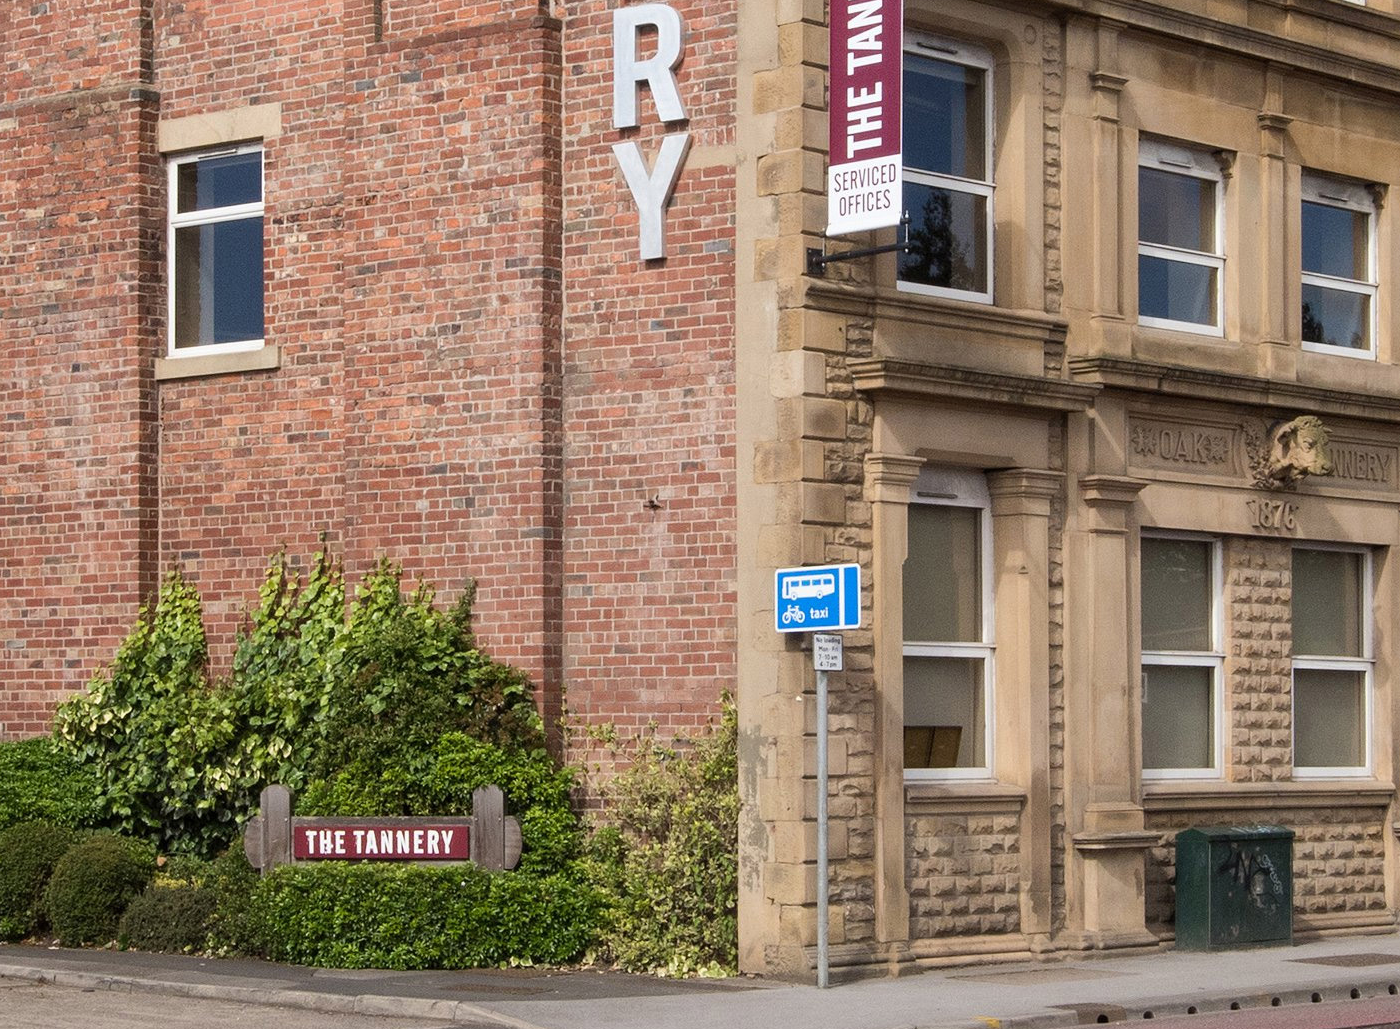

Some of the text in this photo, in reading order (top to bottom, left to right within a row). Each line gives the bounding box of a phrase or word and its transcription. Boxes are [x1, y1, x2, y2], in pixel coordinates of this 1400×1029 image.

[847, 81, 883, 159] THE
[833, 162, 897, 193] SERVICED
[839, 188, 891, 217] OFFICES
[1159, 430, 1392, 482] OAK NNERY
[1248, 500, 1297, 529] 1876
[809, 606, 829, 620] taxi
[824, 637, 841, 645] loading
[305, 829, 454, 855] THE TANNERY
